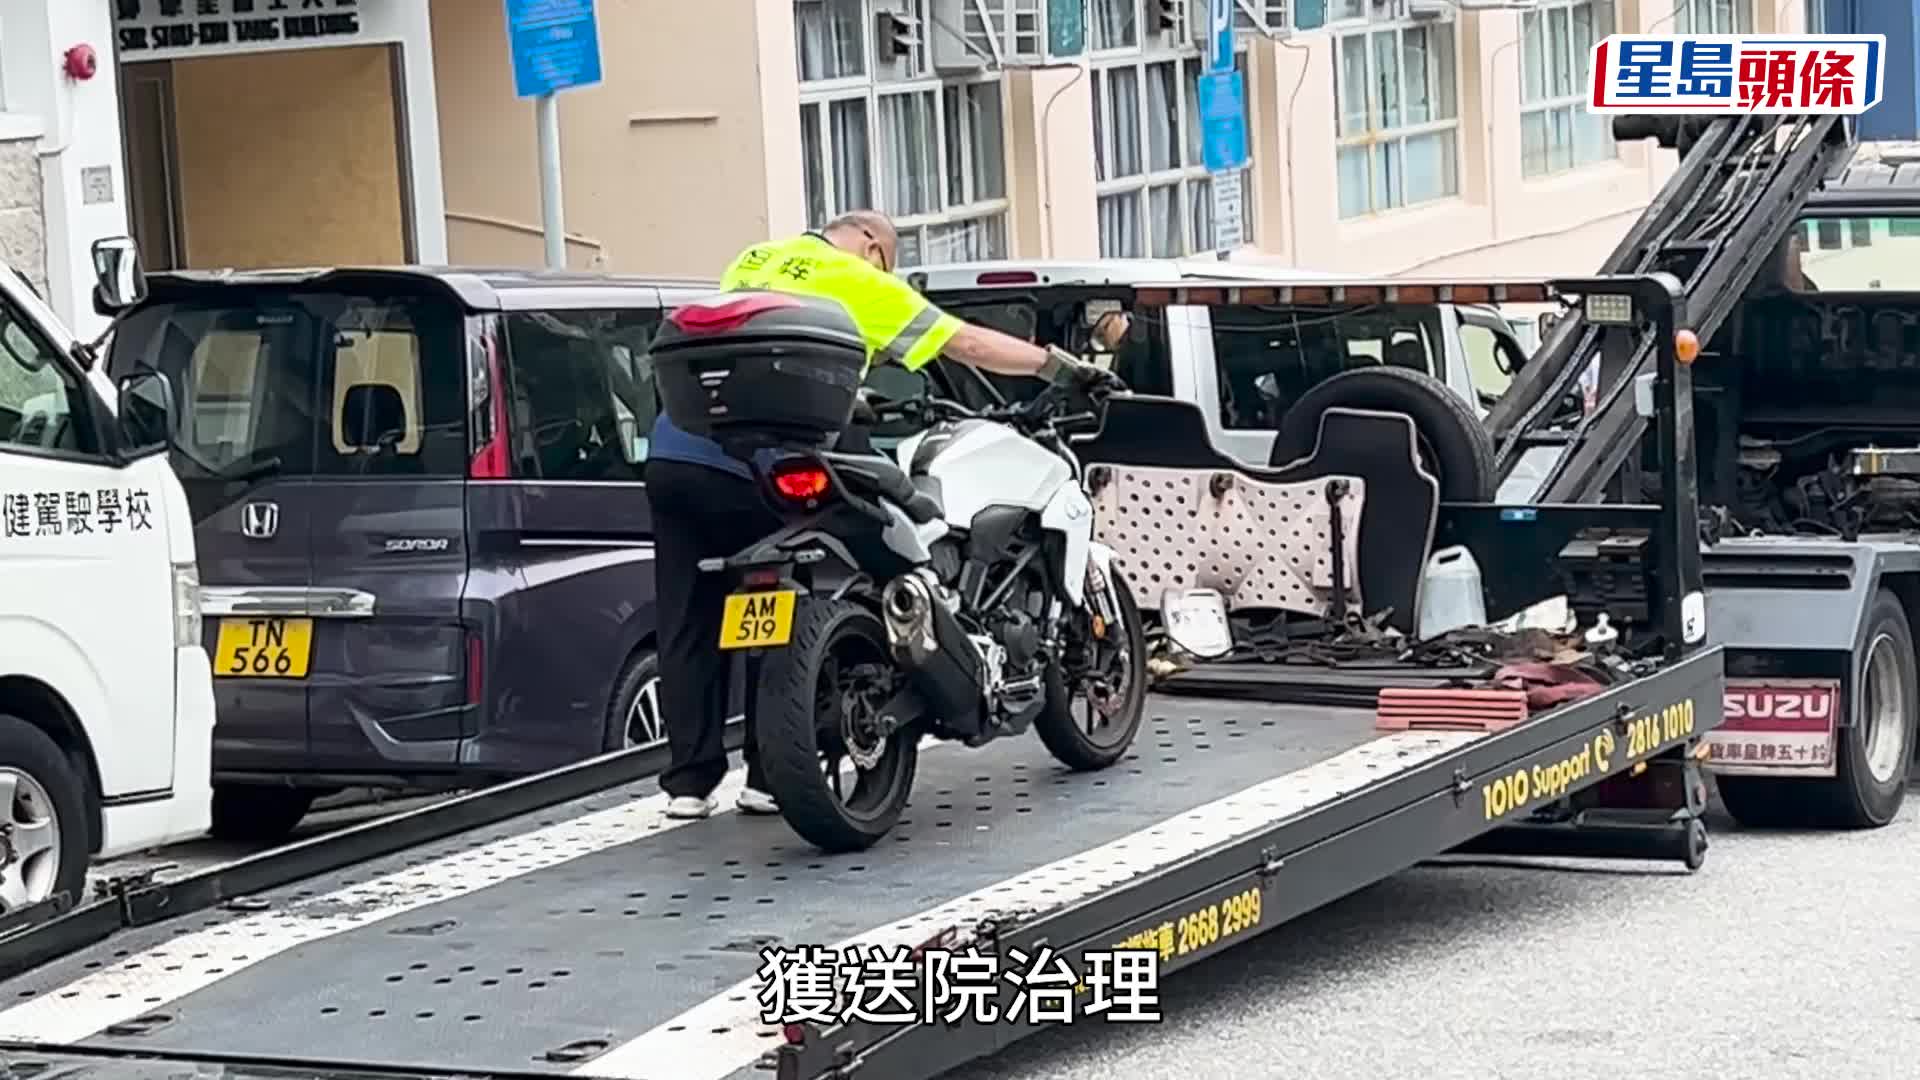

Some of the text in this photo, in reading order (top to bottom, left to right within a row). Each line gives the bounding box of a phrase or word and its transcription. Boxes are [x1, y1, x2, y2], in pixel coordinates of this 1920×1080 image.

[3, 488, 153, 537] 健駕駛學校
[742, 595, 777, 619] AM
[249, 620, 284, 647] TN
[736, 620, 777, 641] 519
[230, 647, 291, 673] 566
[1724, 694, 1829, 718] SUZU
[1482, 699, 1694, 820] 1010 Support 2816 1010
[1177, 905, 1218, 955] 2668
[1222, 887, 1261, 936] 2999
